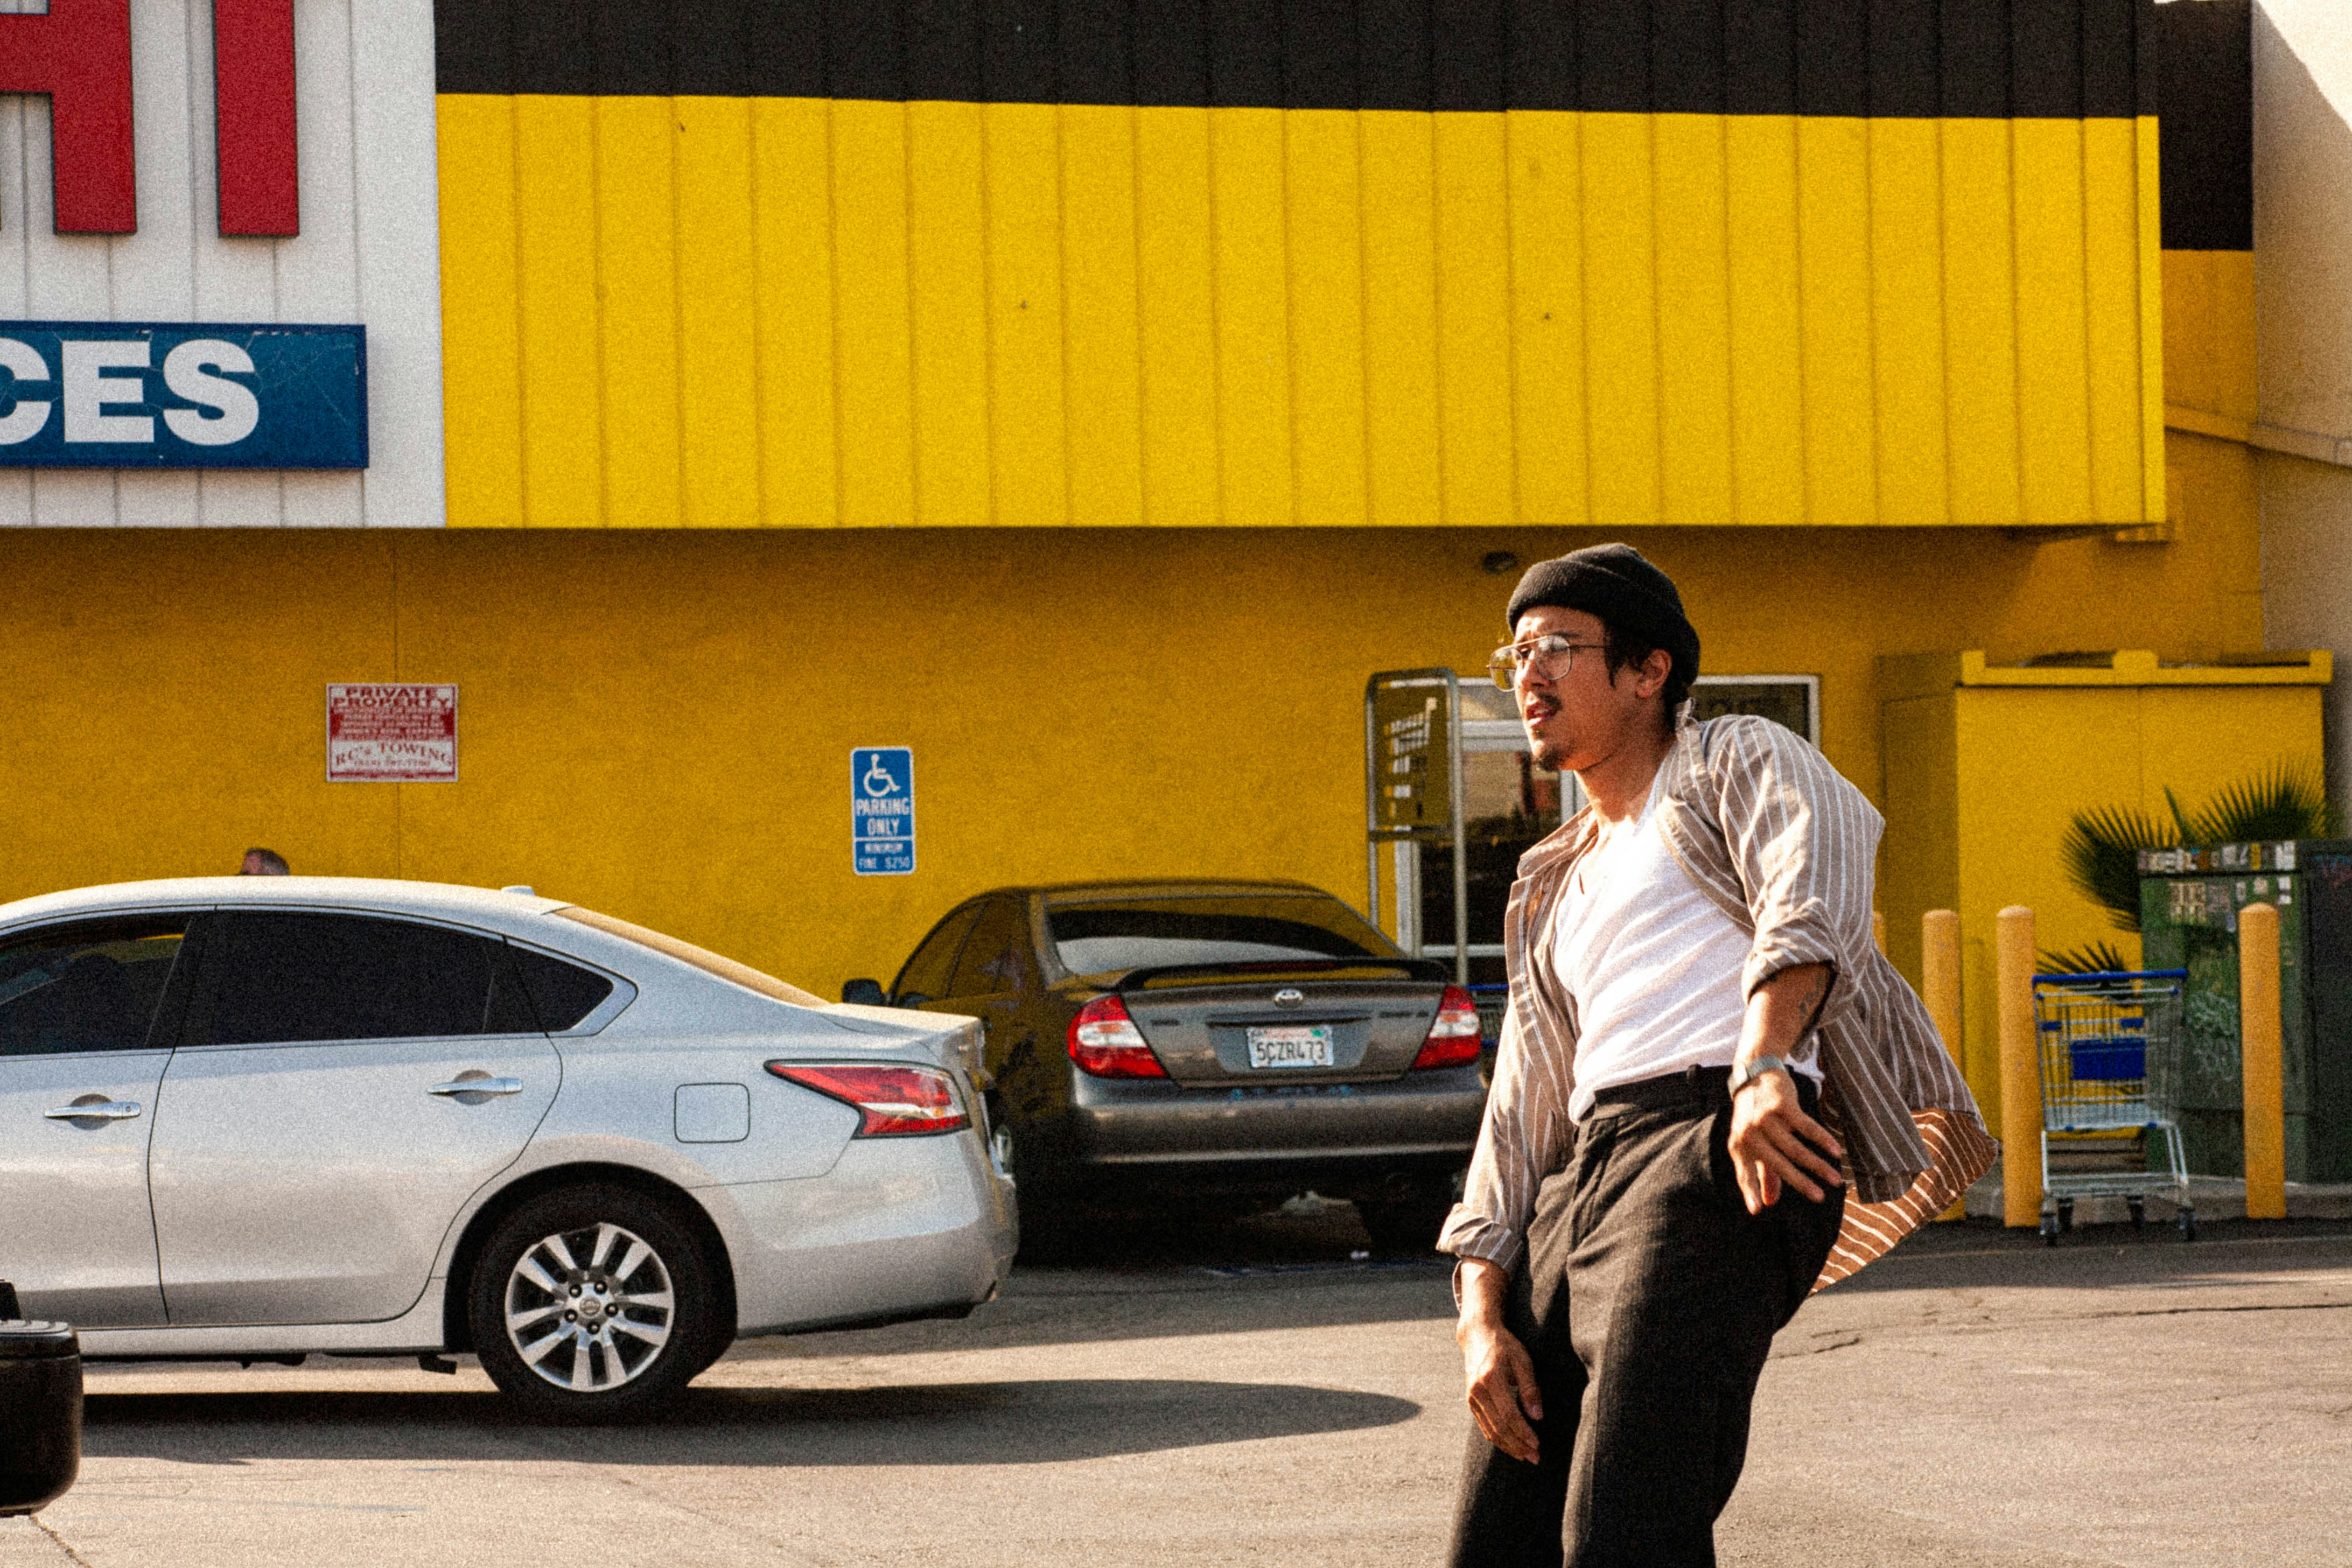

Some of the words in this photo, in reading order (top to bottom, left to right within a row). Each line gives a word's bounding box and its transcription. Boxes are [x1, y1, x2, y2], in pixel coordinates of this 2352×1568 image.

[346, 687, 438, 697] PRIVATE
[333, 697, 450, 708] PROPERTY
[377, 742, 453, 767] TOWING
[856, 797, 910, 816] PARKING
[866, 817, 900, 836] ONLY
[858, 857, 877, 869] FINE
[1256, 1040, 1325, 1061] 5CZR473
